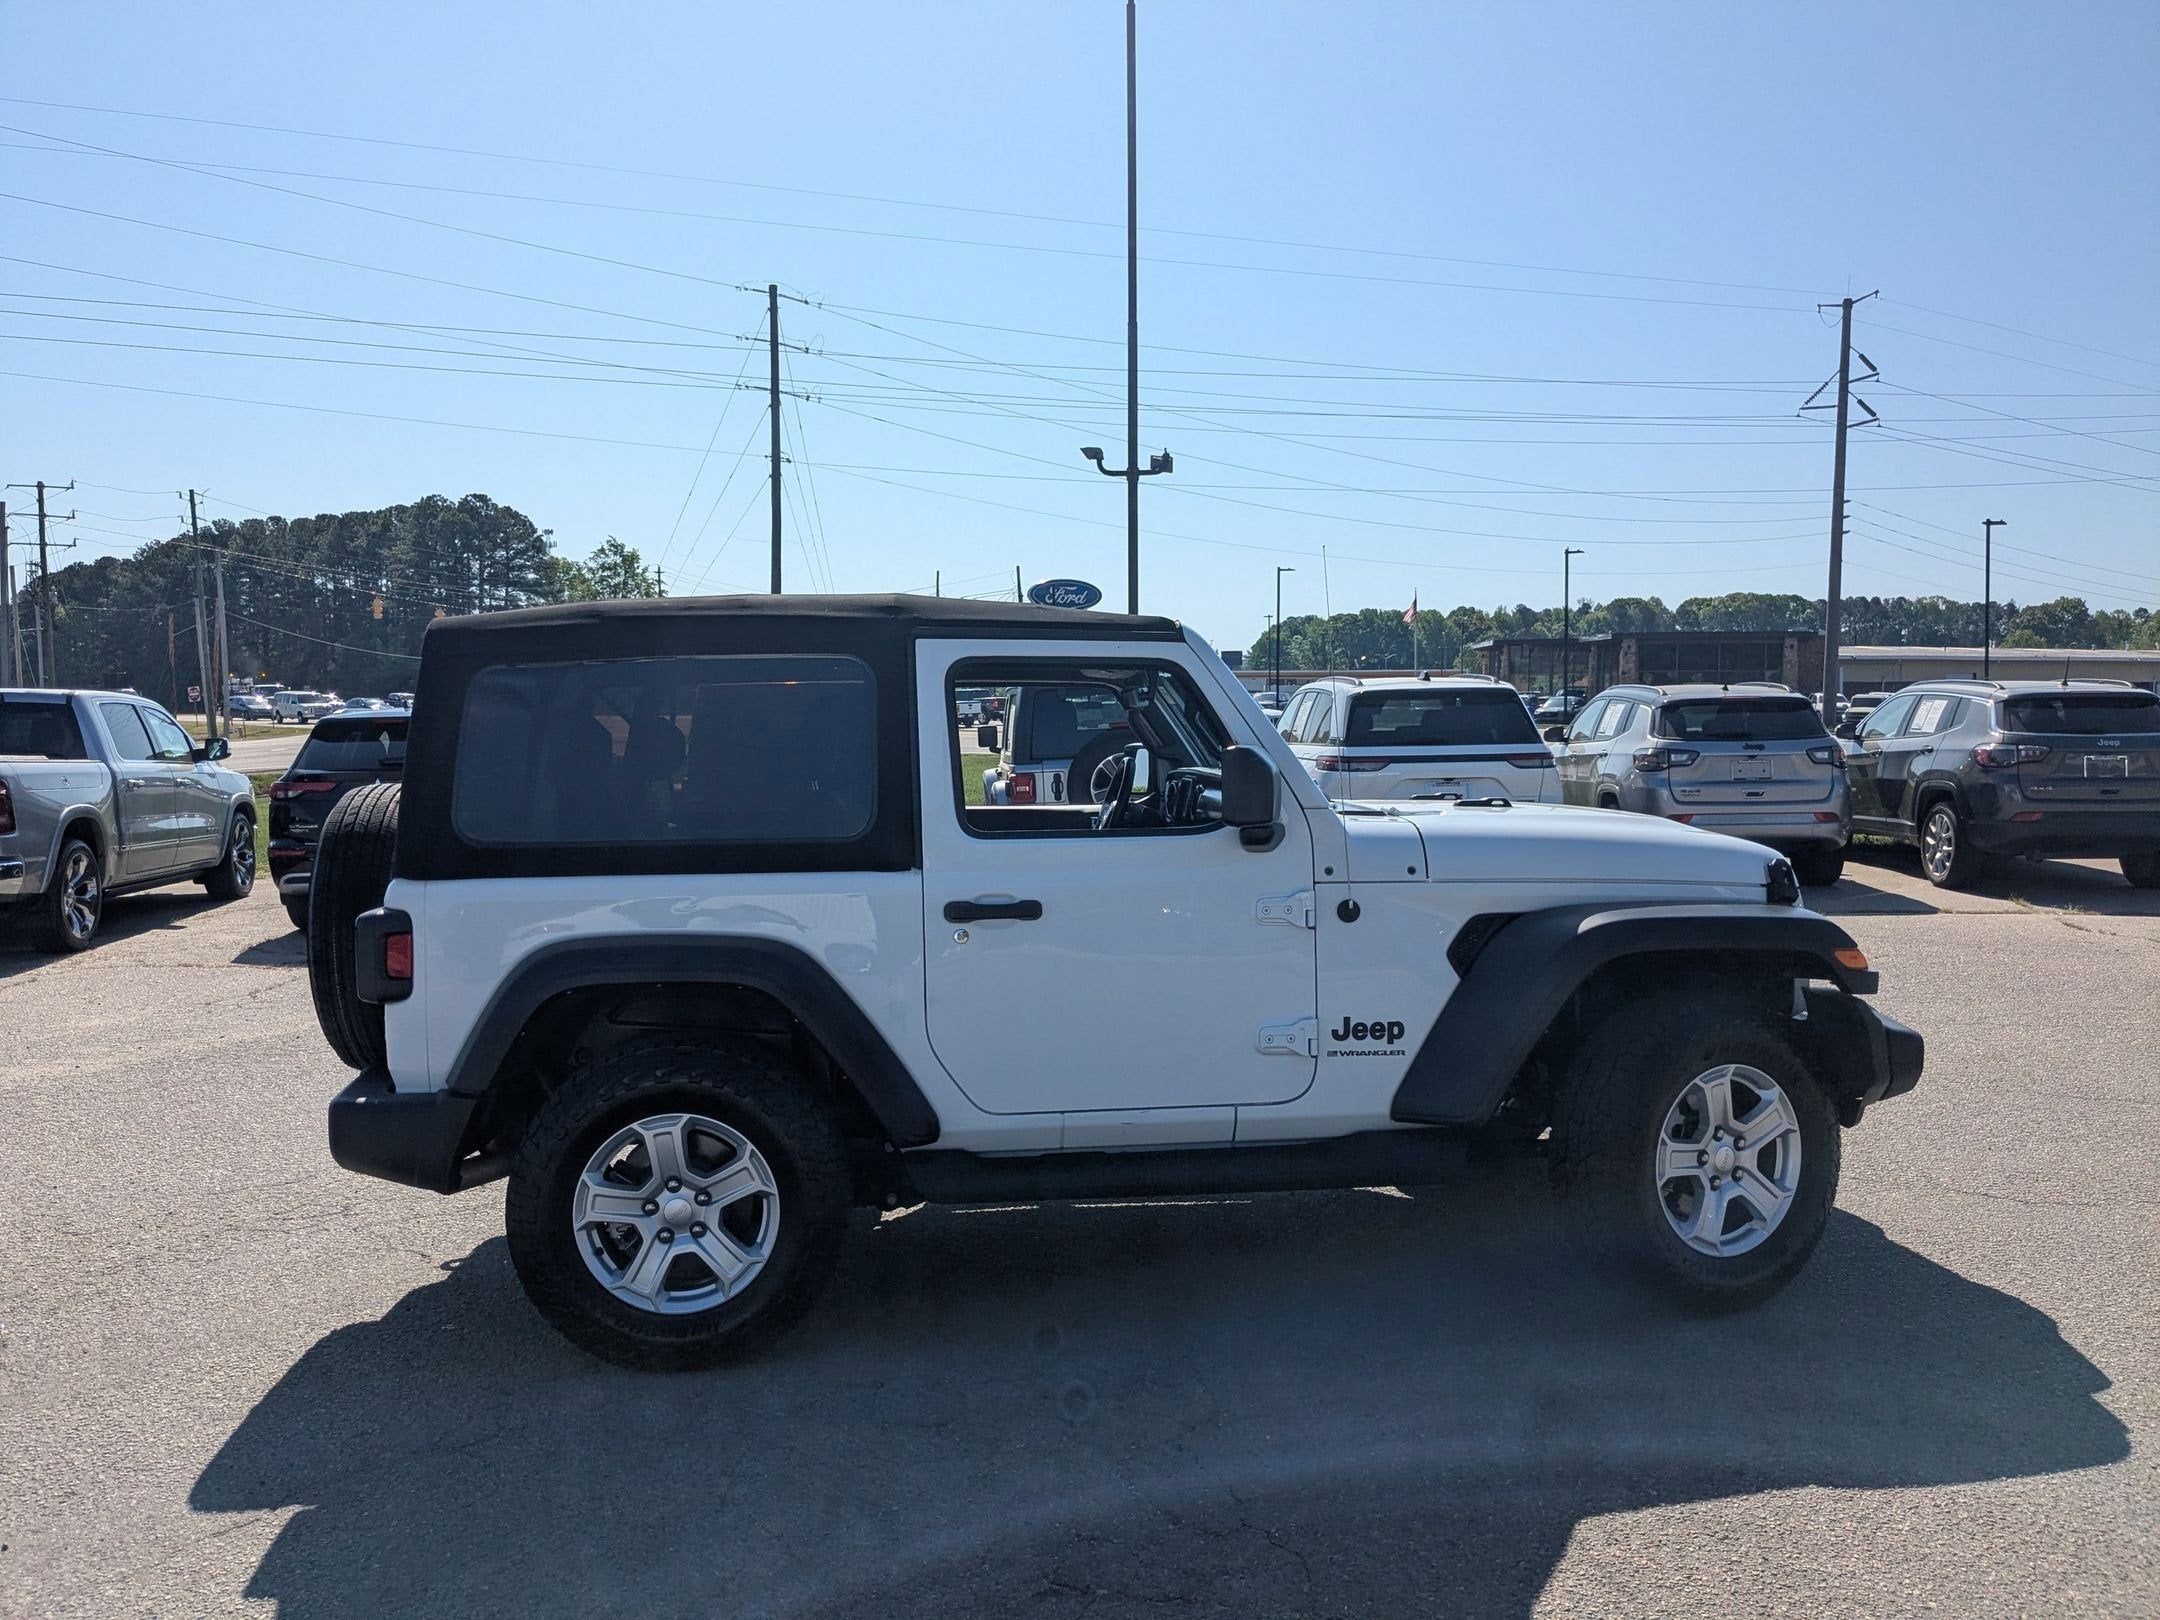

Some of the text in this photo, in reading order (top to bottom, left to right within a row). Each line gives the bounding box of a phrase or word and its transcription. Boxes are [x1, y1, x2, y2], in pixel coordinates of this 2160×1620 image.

[1045, 586, 1088, 604] Ford
[2097, 739, 2120, 747] Jeep
[1331, 1016, 1405, 1045] Jeep
